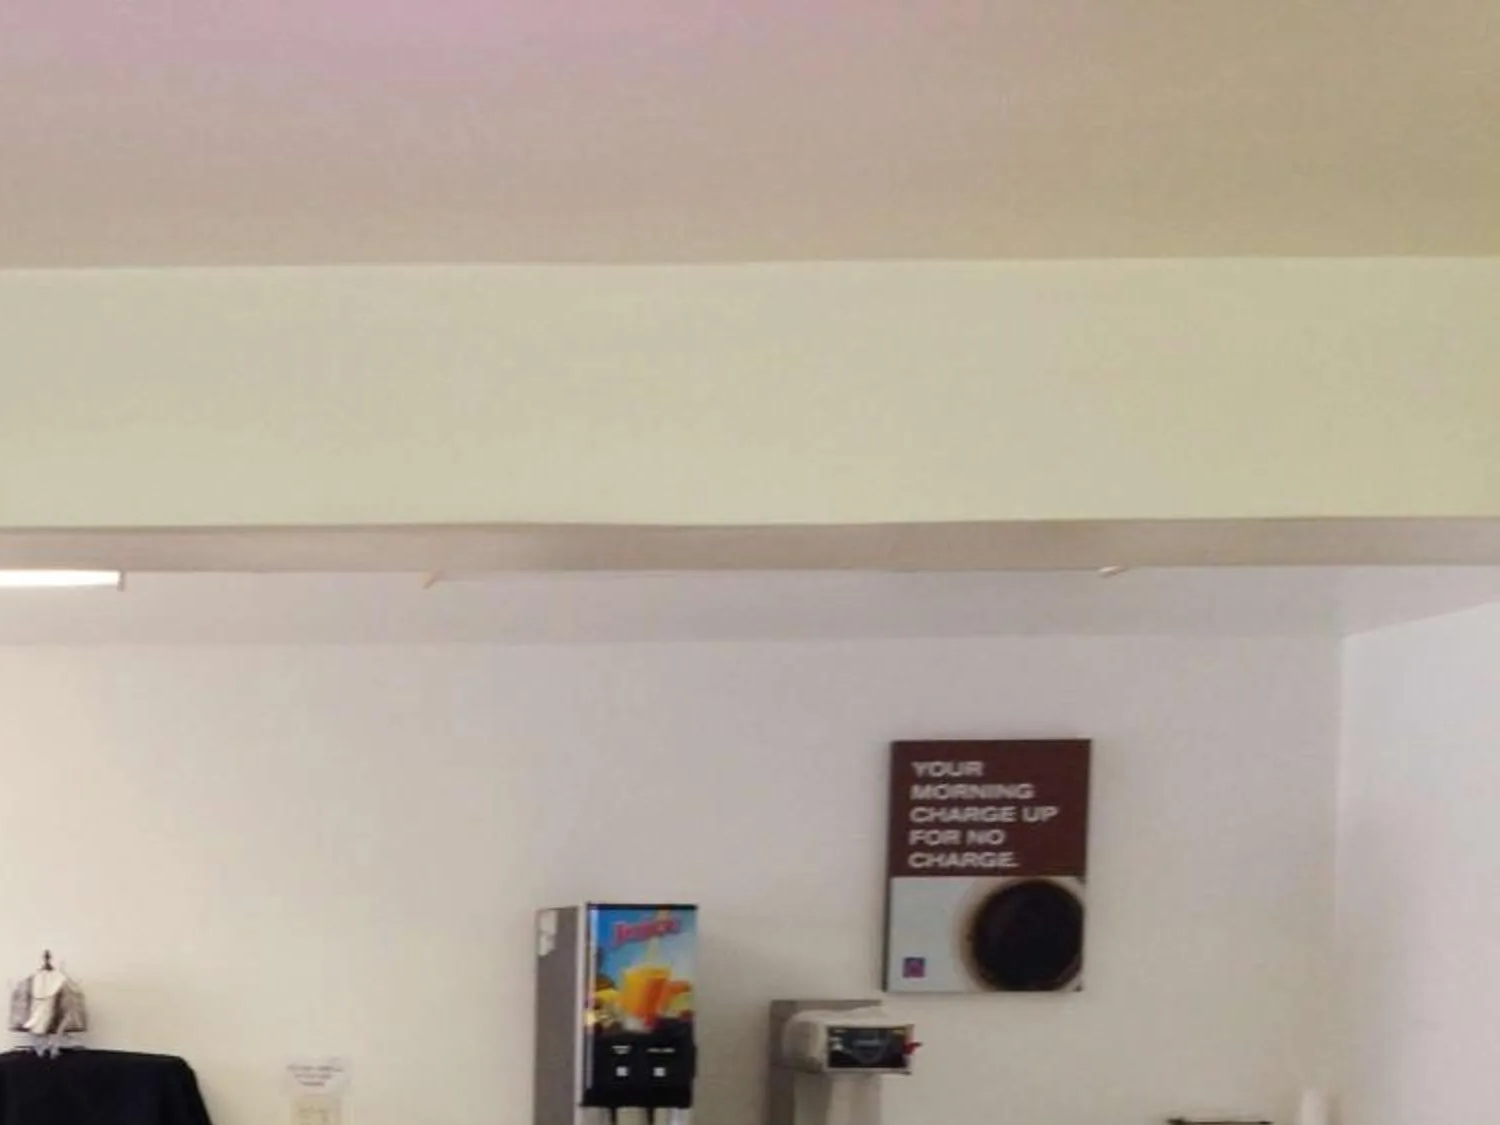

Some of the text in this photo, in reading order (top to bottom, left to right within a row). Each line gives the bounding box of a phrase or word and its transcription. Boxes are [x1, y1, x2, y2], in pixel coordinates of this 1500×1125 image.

[911, 761, 986, 777] YOUR
[909, 783, 1036, 800] MORNING
[908, 806, 1060, 823] CHARGE UP
[908, 829, 1006, 846] FOR NO
